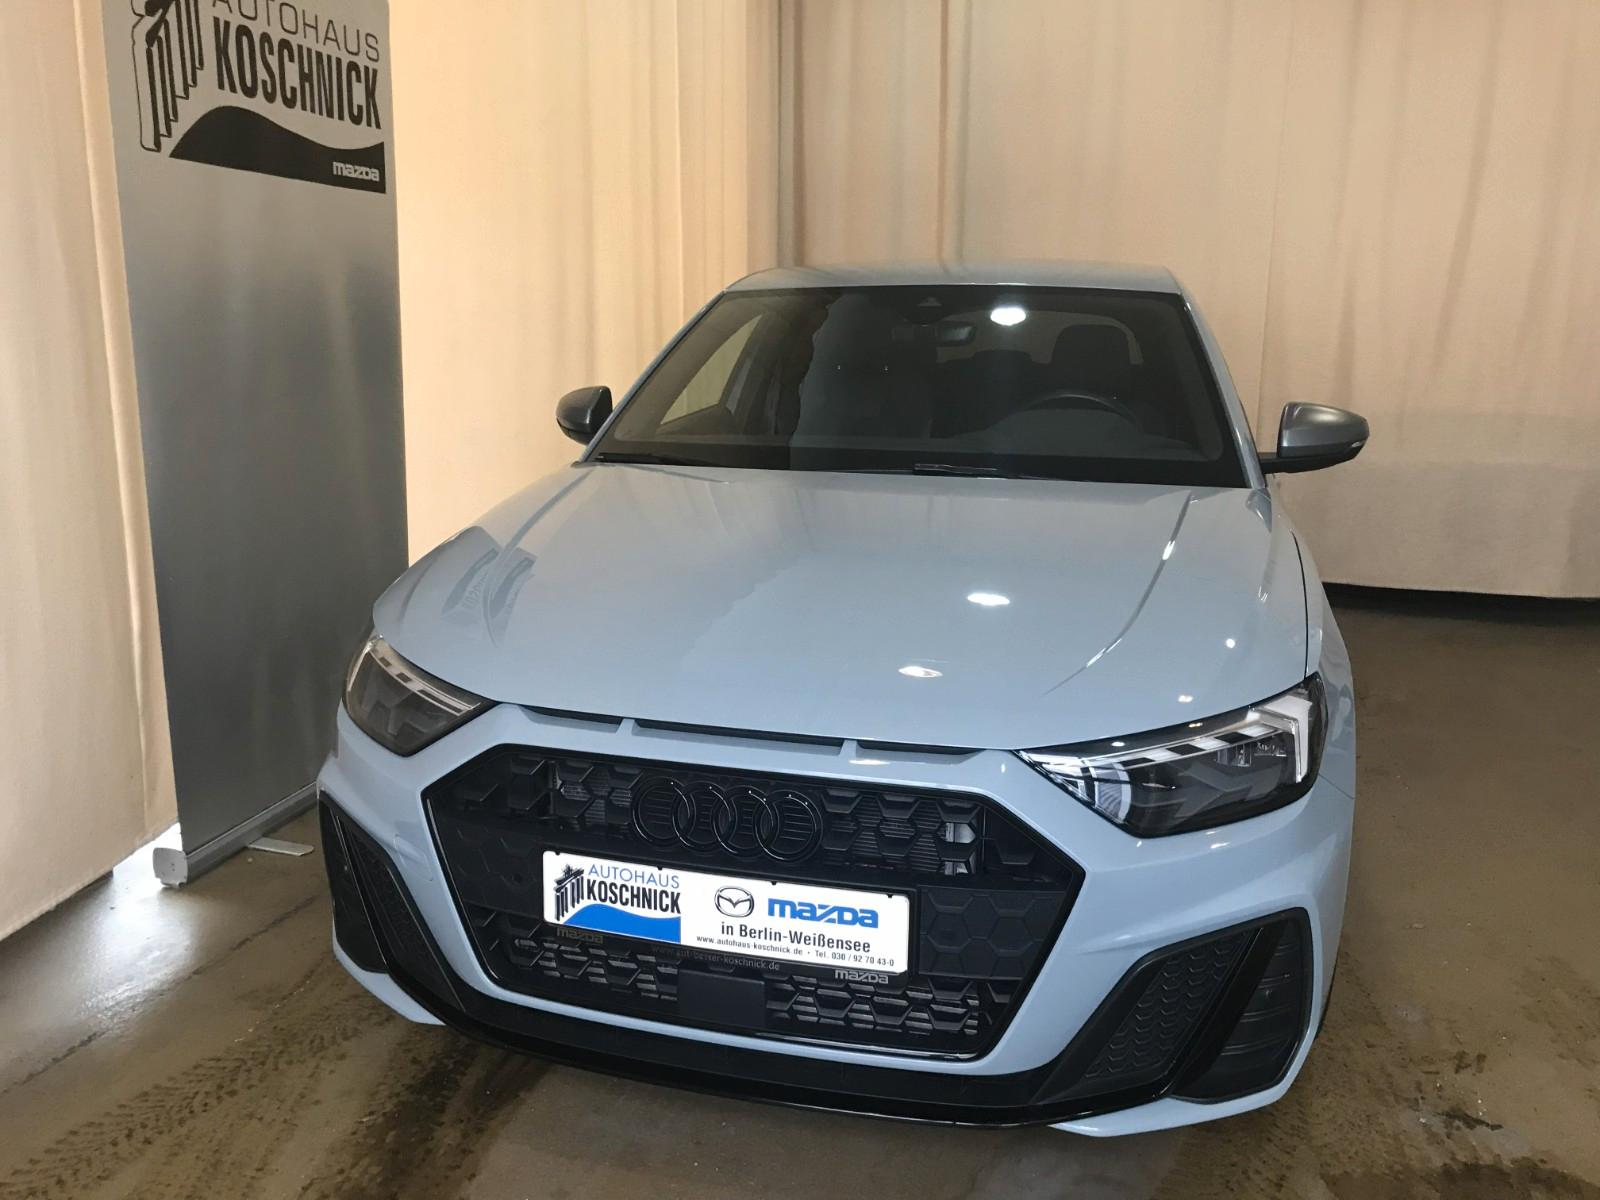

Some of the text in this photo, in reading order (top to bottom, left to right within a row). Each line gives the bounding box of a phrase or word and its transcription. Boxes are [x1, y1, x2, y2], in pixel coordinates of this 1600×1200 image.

[213, 16, 382, 130] KOSCHNICK
[332, 160, 380, 182] mazda
[588, 863, 680, 889] AUTOHAUS
[586, 878, 681, 914] KOSCHNICK
[767, 897, 879, 929] mazda
[721, 921, 871, 953] in Berlin-Weißensee
[815, 950, 827, 958] Tel.
[831, 951, 845, 961] 030
[853, 953, 863, 963] 92
[834, 968, 889, 985] mazda
